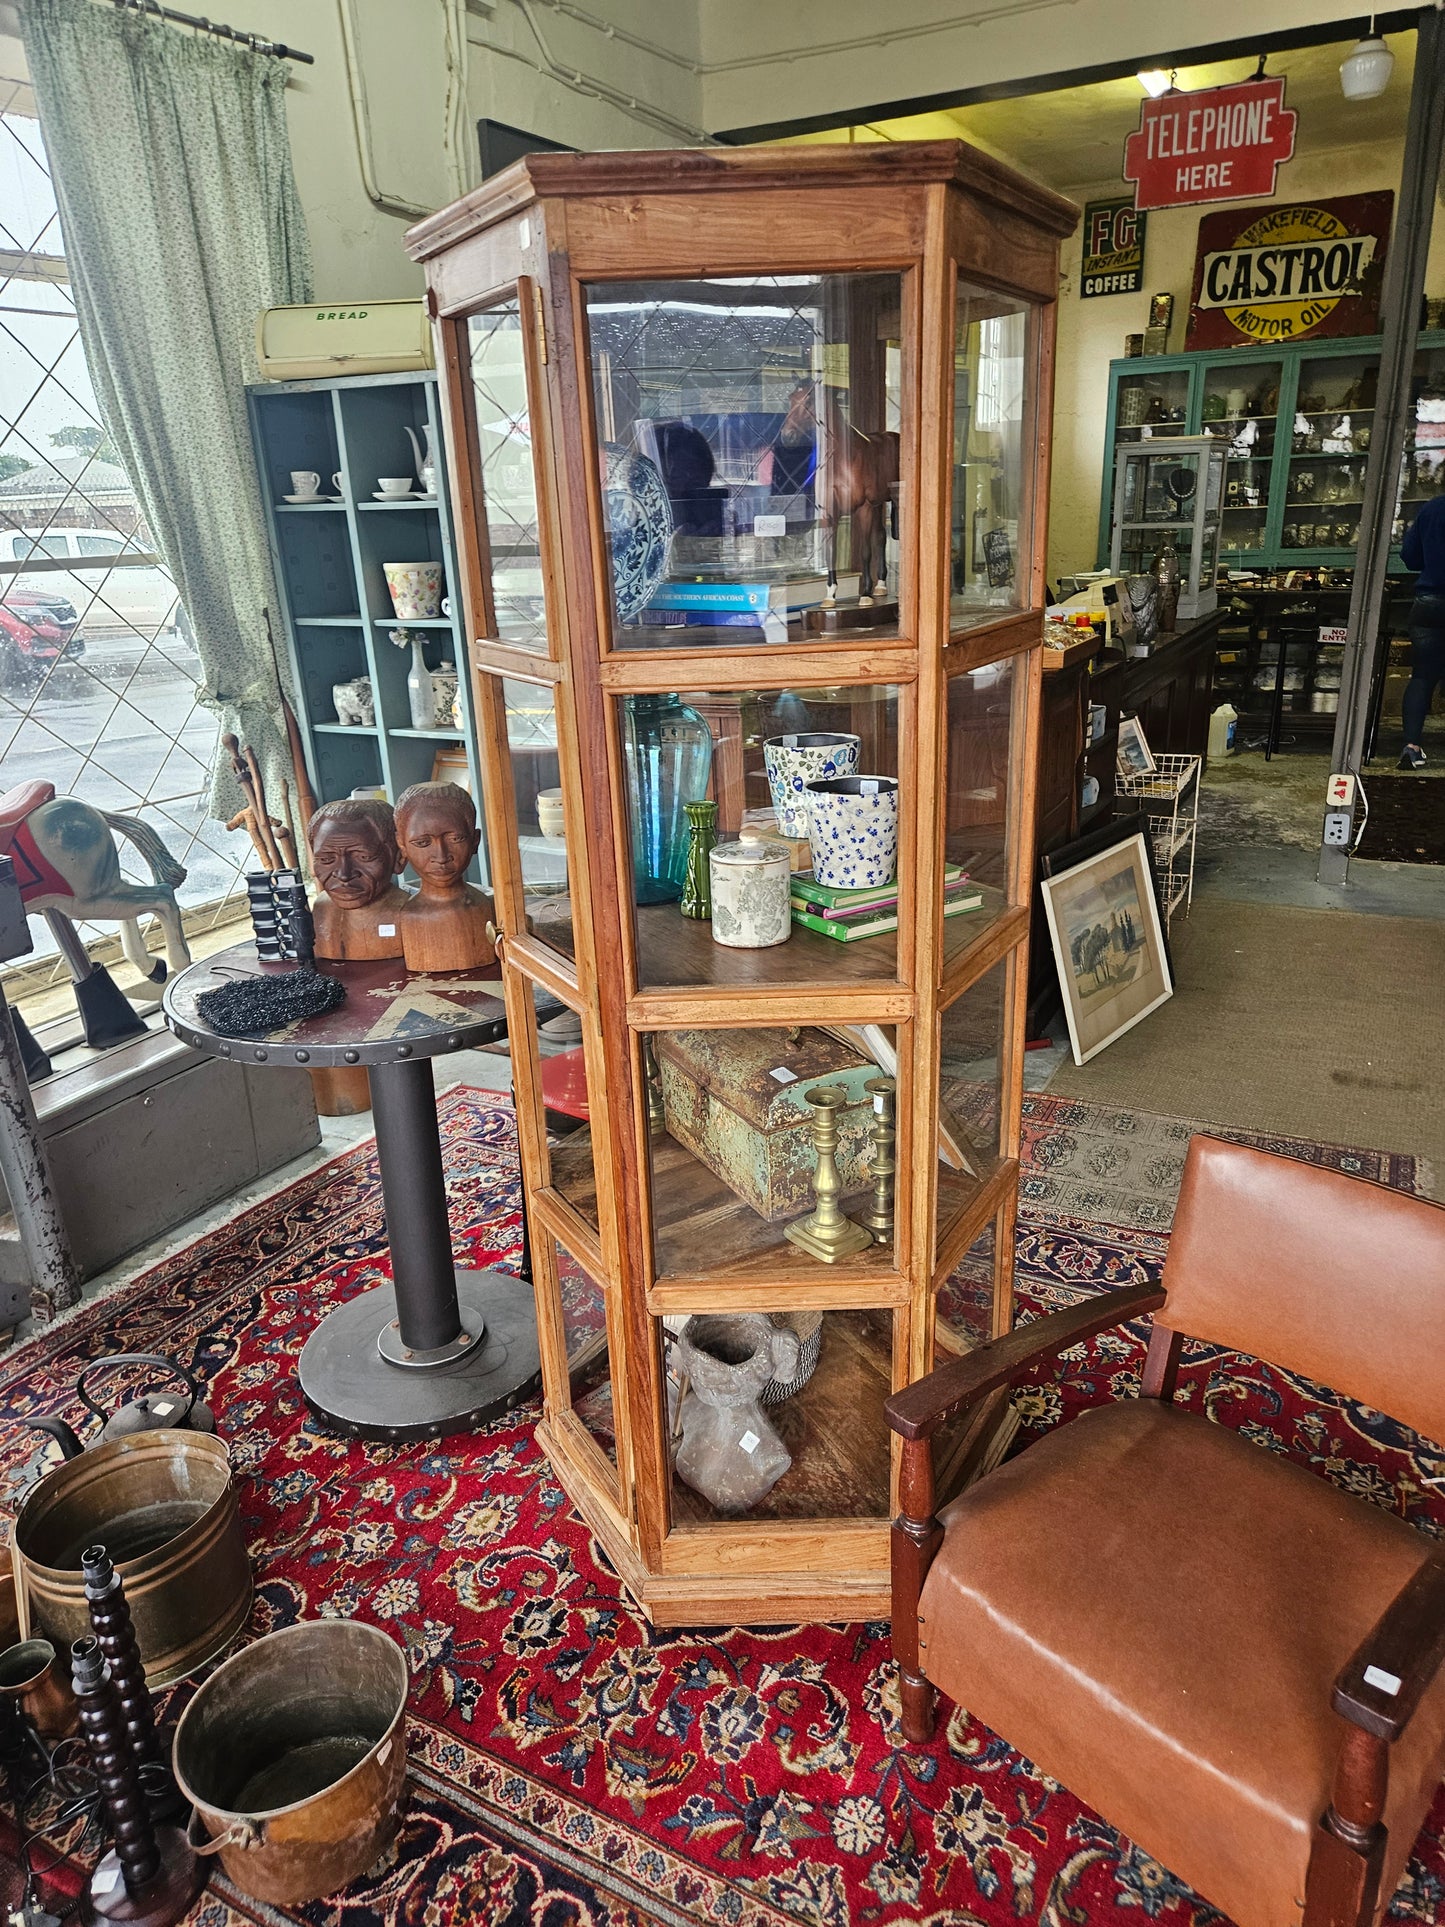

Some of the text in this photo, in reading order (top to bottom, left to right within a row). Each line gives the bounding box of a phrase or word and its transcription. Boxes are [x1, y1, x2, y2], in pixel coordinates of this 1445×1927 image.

[1146, 98, 1278, 160] TELEPHONE
[1175, 161, 1234, 193] HERE
[1088, 206, 1138, 258] FG
[1243, 208, 1338, 244] WAKEFIELD
[1086, 248, 1139, 273] INSTANT
[1085, 273, 1136, 295] COFFEE
[315, 311, 369, 321] BREAD
[1234, 301, 1332, 337] MOTOR OIL
[1322, 634, 1347, 642] ENTR
